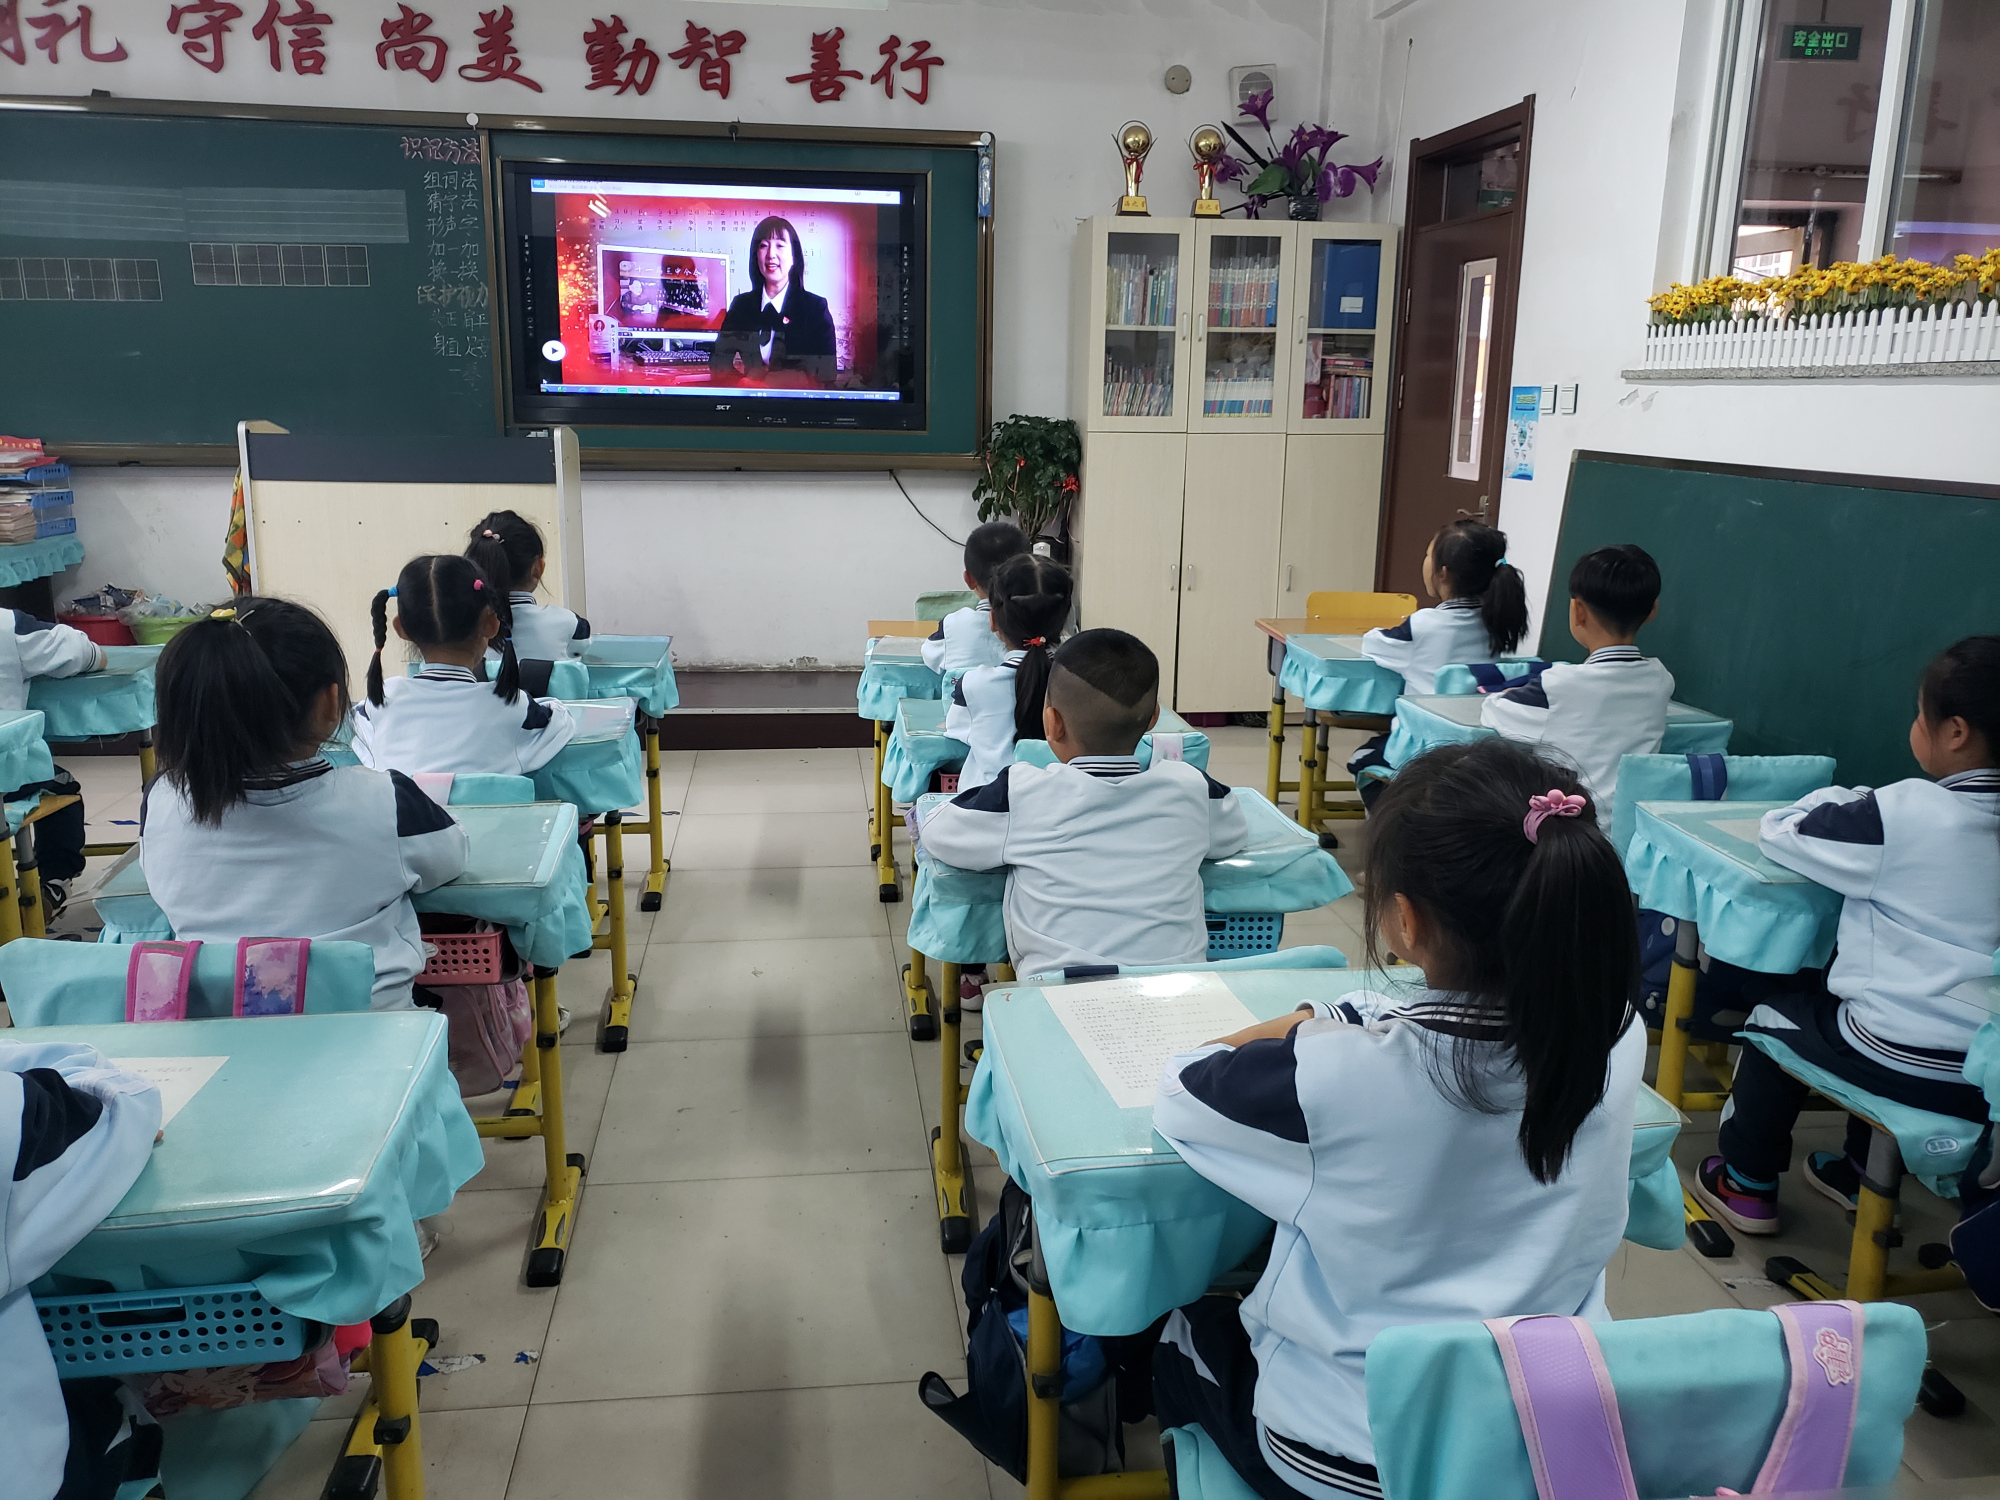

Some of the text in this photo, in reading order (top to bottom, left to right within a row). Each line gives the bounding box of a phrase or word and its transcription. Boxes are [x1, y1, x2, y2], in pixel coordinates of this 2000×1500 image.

[1792, 30, 1848, 48] 安全出口
[167, 2, 333, 75] 守信
[376, 2, 543, 93] 尚美
[583, 14, 747, 99] 勤智
[785, 26, 945, 105] 善行
[1804, 48, 1833, 56] EXIT
[423, 169, 478, 191] 组词法
[426, 190, 478, 213] 猜字法
[427, 240, 479, 258] 加一加
